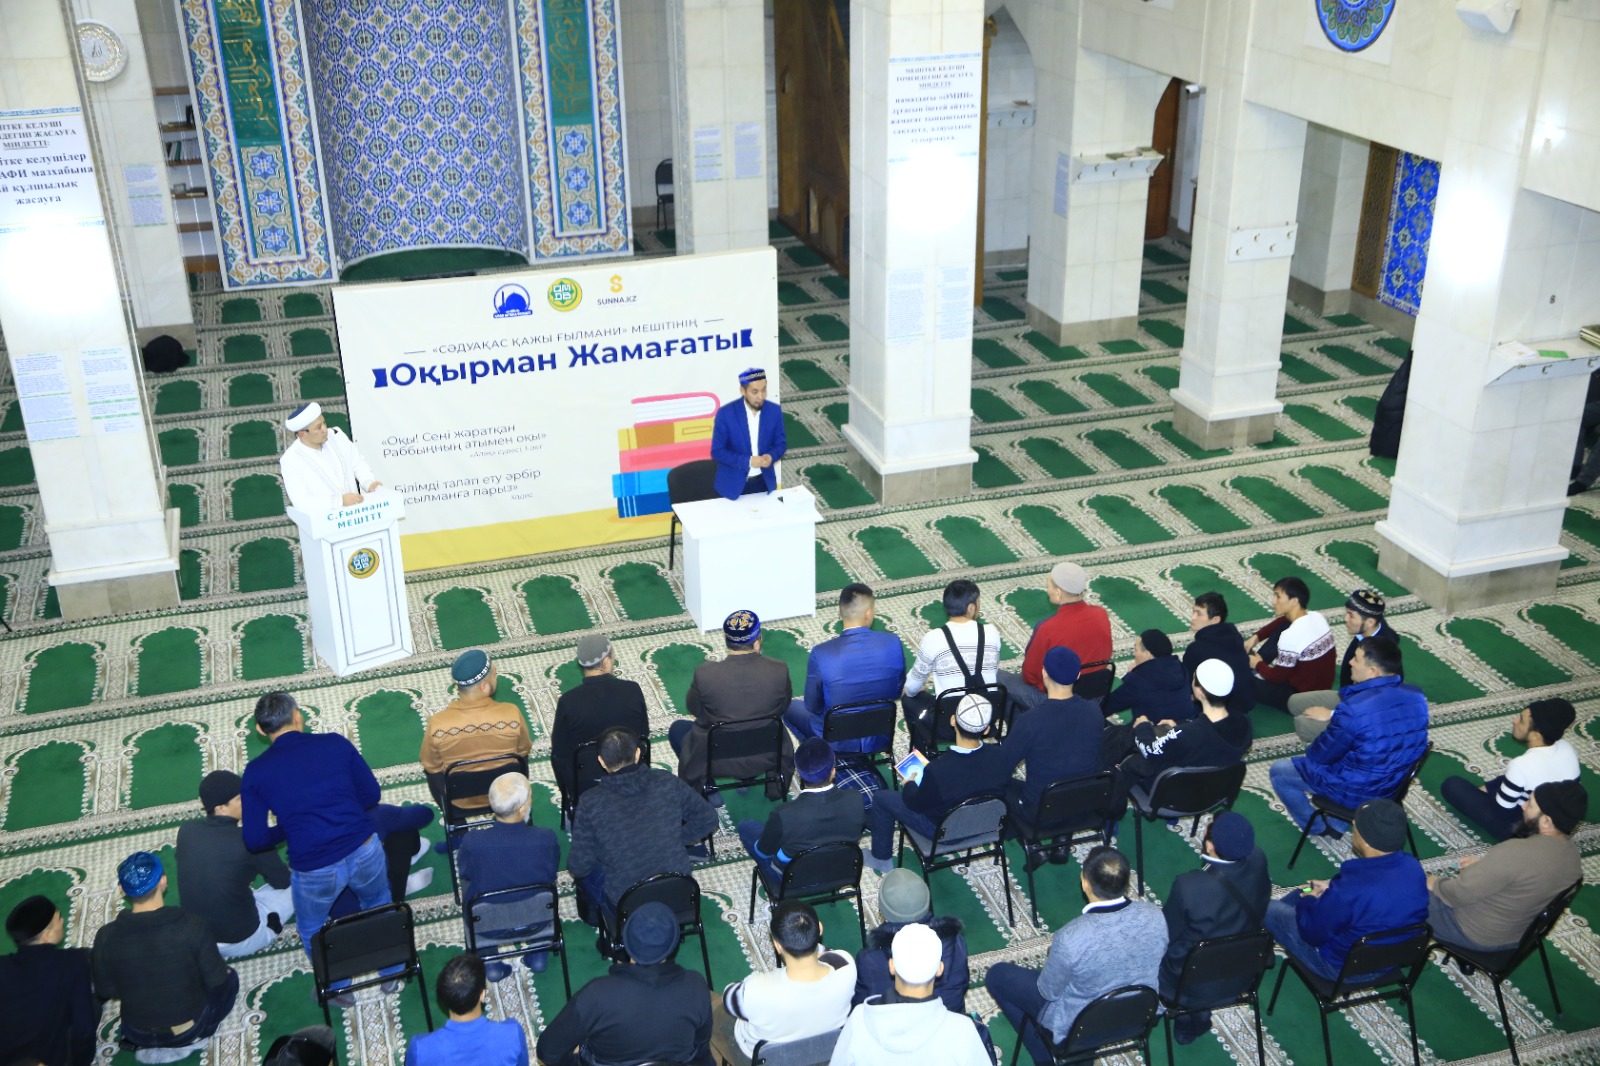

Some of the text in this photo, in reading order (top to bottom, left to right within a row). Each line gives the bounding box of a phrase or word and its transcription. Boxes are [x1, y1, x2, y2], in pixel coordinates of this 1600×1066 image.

[0, 121, 62, 131] ІТКЕ КЕЛУШІ
[0, 131, 33, 140] ДЕГІНІ
[26, 152, 87, 165] келушілер
[31, 166, 94, 178] мазхабына
[597, 295, 637, 306] SUNNA.KZ
[432, 318, 699, 355] «СӘДУАҚАС ҚАЖЫ ҒЫЛМАНИ» МЕШІТІНІҢ
[390, 332, 738, 386] Оқырман Жамағаты
[381, 424, 516, 447] «Оқы! Сені жаратқан
[383, 432, 547, 459] Раббыңның атымен оқы»
[443, 475, 479, 490] талап
[482, 474, 502, 485] ету
[505, 468, 541, 482] әрбір
[403, 484, 518, 506] сылманға парыз»
[337, 512, 382, 529] МЕШІТІ
